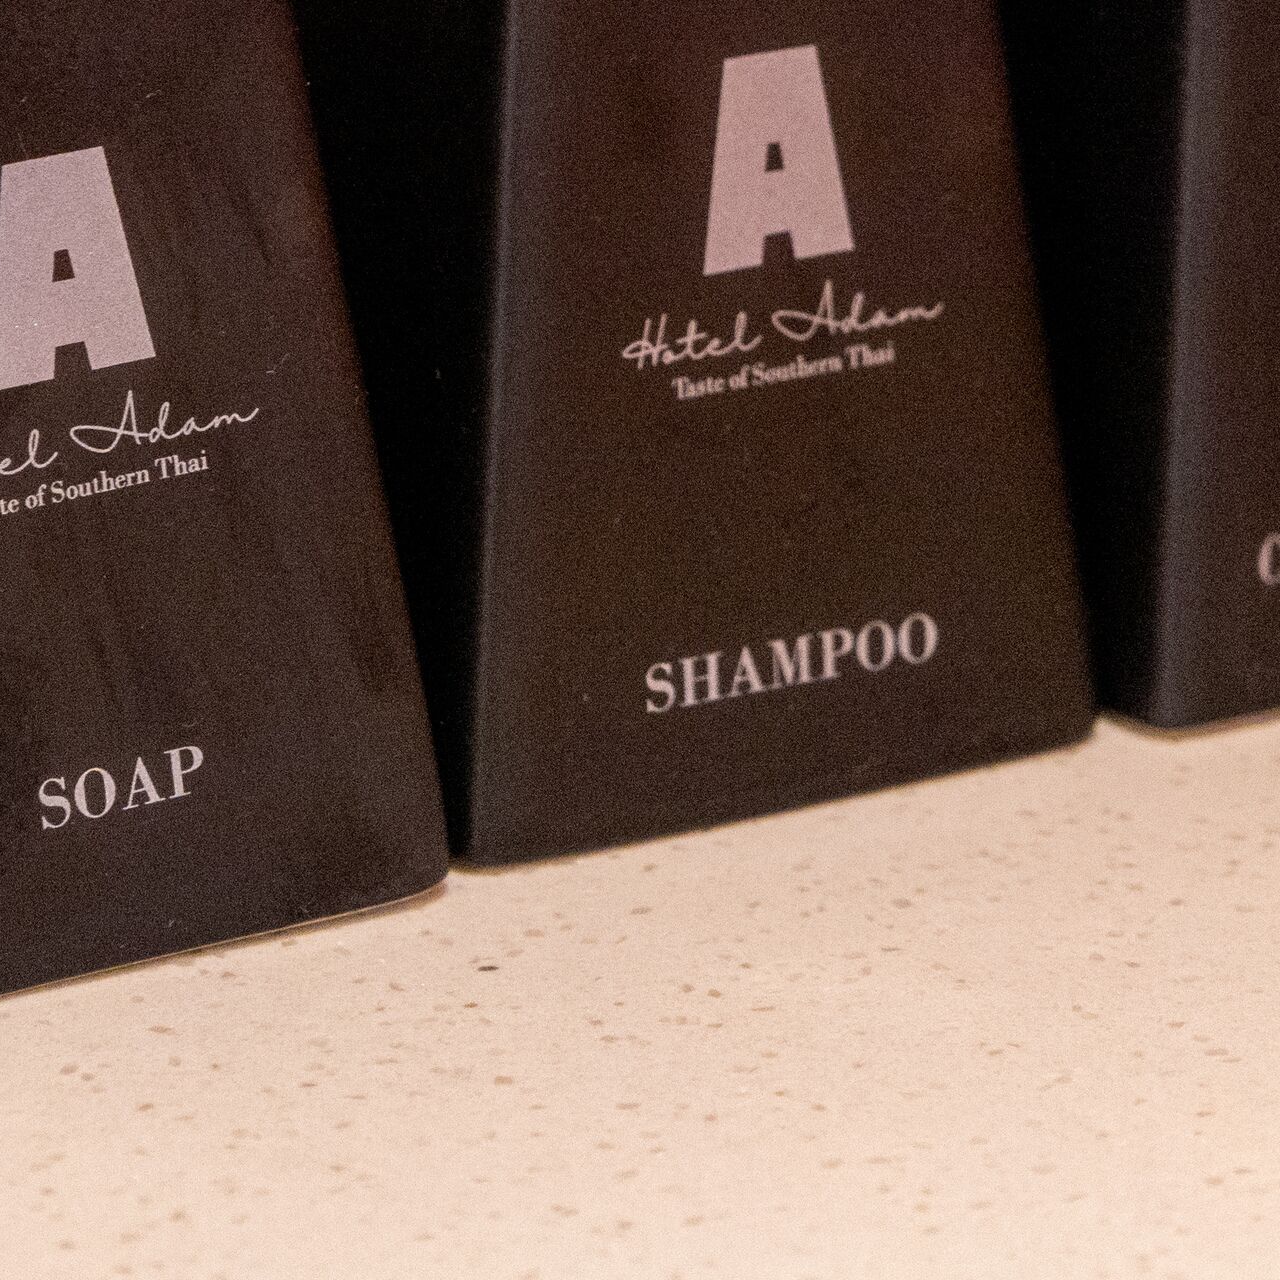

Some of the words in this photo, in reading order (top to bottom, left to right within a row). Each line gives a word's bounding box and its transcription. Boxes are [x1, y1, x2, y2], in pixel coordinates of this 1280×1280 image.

[703, 44, 855, 276] A
[622, 311, 763, 370] Hotel
[771, 278, 945, 342] Adam
[70, 390, 260, 453] Adam
[24, 484, 47, 511] of
[50, 468, 151, 504] Southern
[154, 450, 209, 481] Thai
[644, 612, 939, 714] SHAMPOO
[38, 745, 204, 830] SOAP
